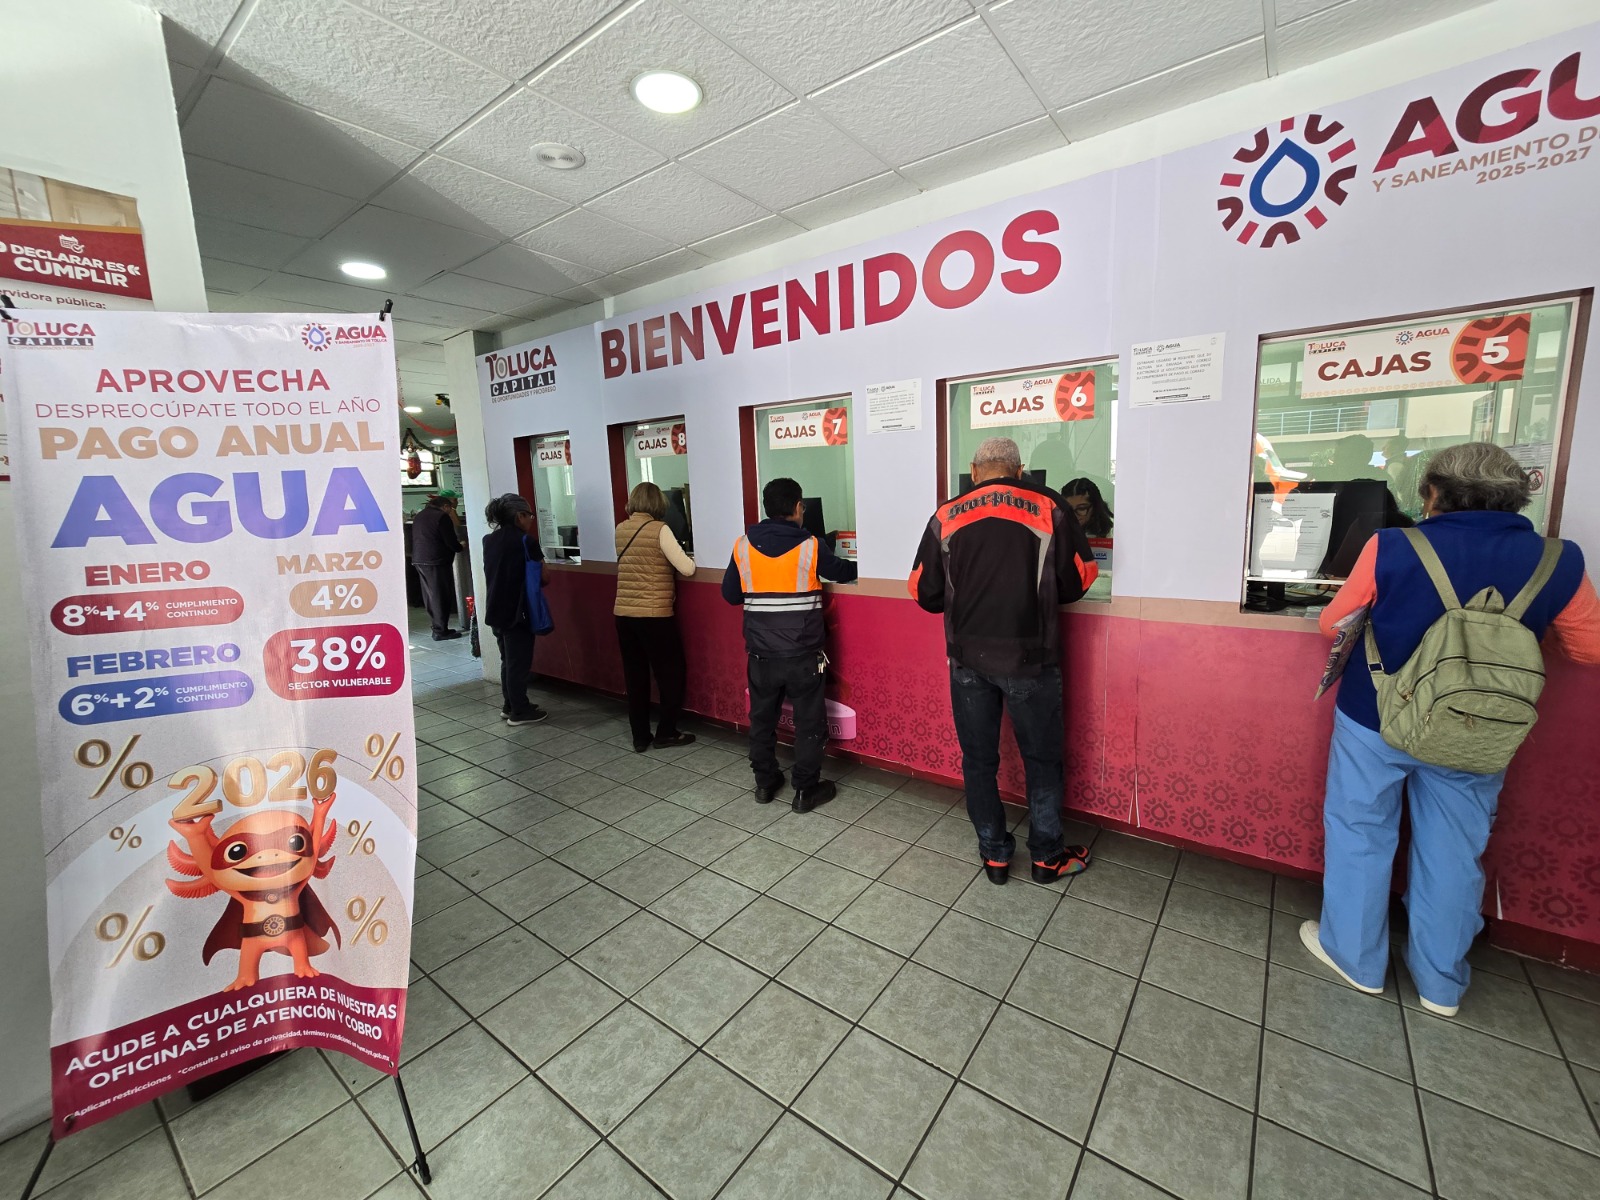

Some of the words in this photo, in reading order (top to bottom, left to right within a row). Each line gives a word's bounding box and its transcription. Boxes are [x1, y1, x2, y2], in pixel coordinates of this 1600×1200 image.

[1373, 179, 1386, 192] Y
[1391, 133, 1570, 188] SANEAMIENTO
[1578, 126, 1600, 145] D
[1476, 146, 1592, 184] 2025-2027
[10, 243, 104, 269] DECLARAR
[106, 261, 127, 273] ES
[14, 257, 128, 287] CUMPLIR
[56, 296, 107, 309] pública:
[601, 209, 1062, 380] BIENVENIDOS
[1, 318, 96, 336] TOLUCA
[335, 325, 387, 340] AGUA
[1416, 328, 1450, 338] AGUA
[9, 337, 93, 346] CAPITAL
[1308, 341, 1346, 350] TOLUCA
[1481, 336, 1510, 365] 5
[485, 345, 557, 382] TOLUCA
[1318, 351, 1431, 381] CAJAS
[96, 368, 330, 393] APROVECHA
[491, 372, 554, 396] CAPITAL
[35, 400, 237, 418] DESPREOCÚPATE
[243, 402, 302, 417] TODO
[310, 402, 331, 415] EL
[337, 396, 381, 414] AÑO
[980, 395, 1044, 415] CAJAS
[1070, 386, 1087, 407] 6
[775, 425, 816, 439] CAJAS
[832, 418, 842, 435] 7
[39, 426, 199, 460] PAGO
[216, 421, 385, 457] ANUAL
[638, 437, 668, 451] CAJAS
[678, 432, 686, 446] 8
[540, 450, 562, 461] CAJAS
[50, 467, 390, 548] AGUA
[84, 560, 211, 587] ENERO
[276, 550, 383, 575] MARZO
[166, 598, 238, 610] CUMPLIMIENTO
[311, 583, 363, 610] 4%
[167, 608, 219, 619] CONTINUO
[67, 642, 241, 678] FEBRERO
[290, 634, 386, 674] 38%
[175, 681, 248, 694] CUMPLIMIENTO
[288, 679, 330, 690] SECTOR
[332, 677, 391, 688] VULNERABLE
[176, 692, 229, 703] CONTINUO
[167, 748, 338, 822] 2026
[65, 1031, 156, 1076] ACUDE
[163, 1024, 181, 1042] A
[187, 986, 317, 1031] CUALQUIERA
[320, 987, 336, 1001] DE
[337, 991, 397, 1020] NUESTRAS
[88, 1033, 210, 1089] OFICINAS
[217, 1018, 247, 1041] DE
[252, 1003, 336, 1028] ATENCIÓN
[337, 1011, 344, 1023] Y
[345, 1015, 382, 1040] COBRO
[112, 1074, 172, 1102] restricciones
[230, 1043, 251, 1056] aviso
[253, 1039, 263, 1047] de
